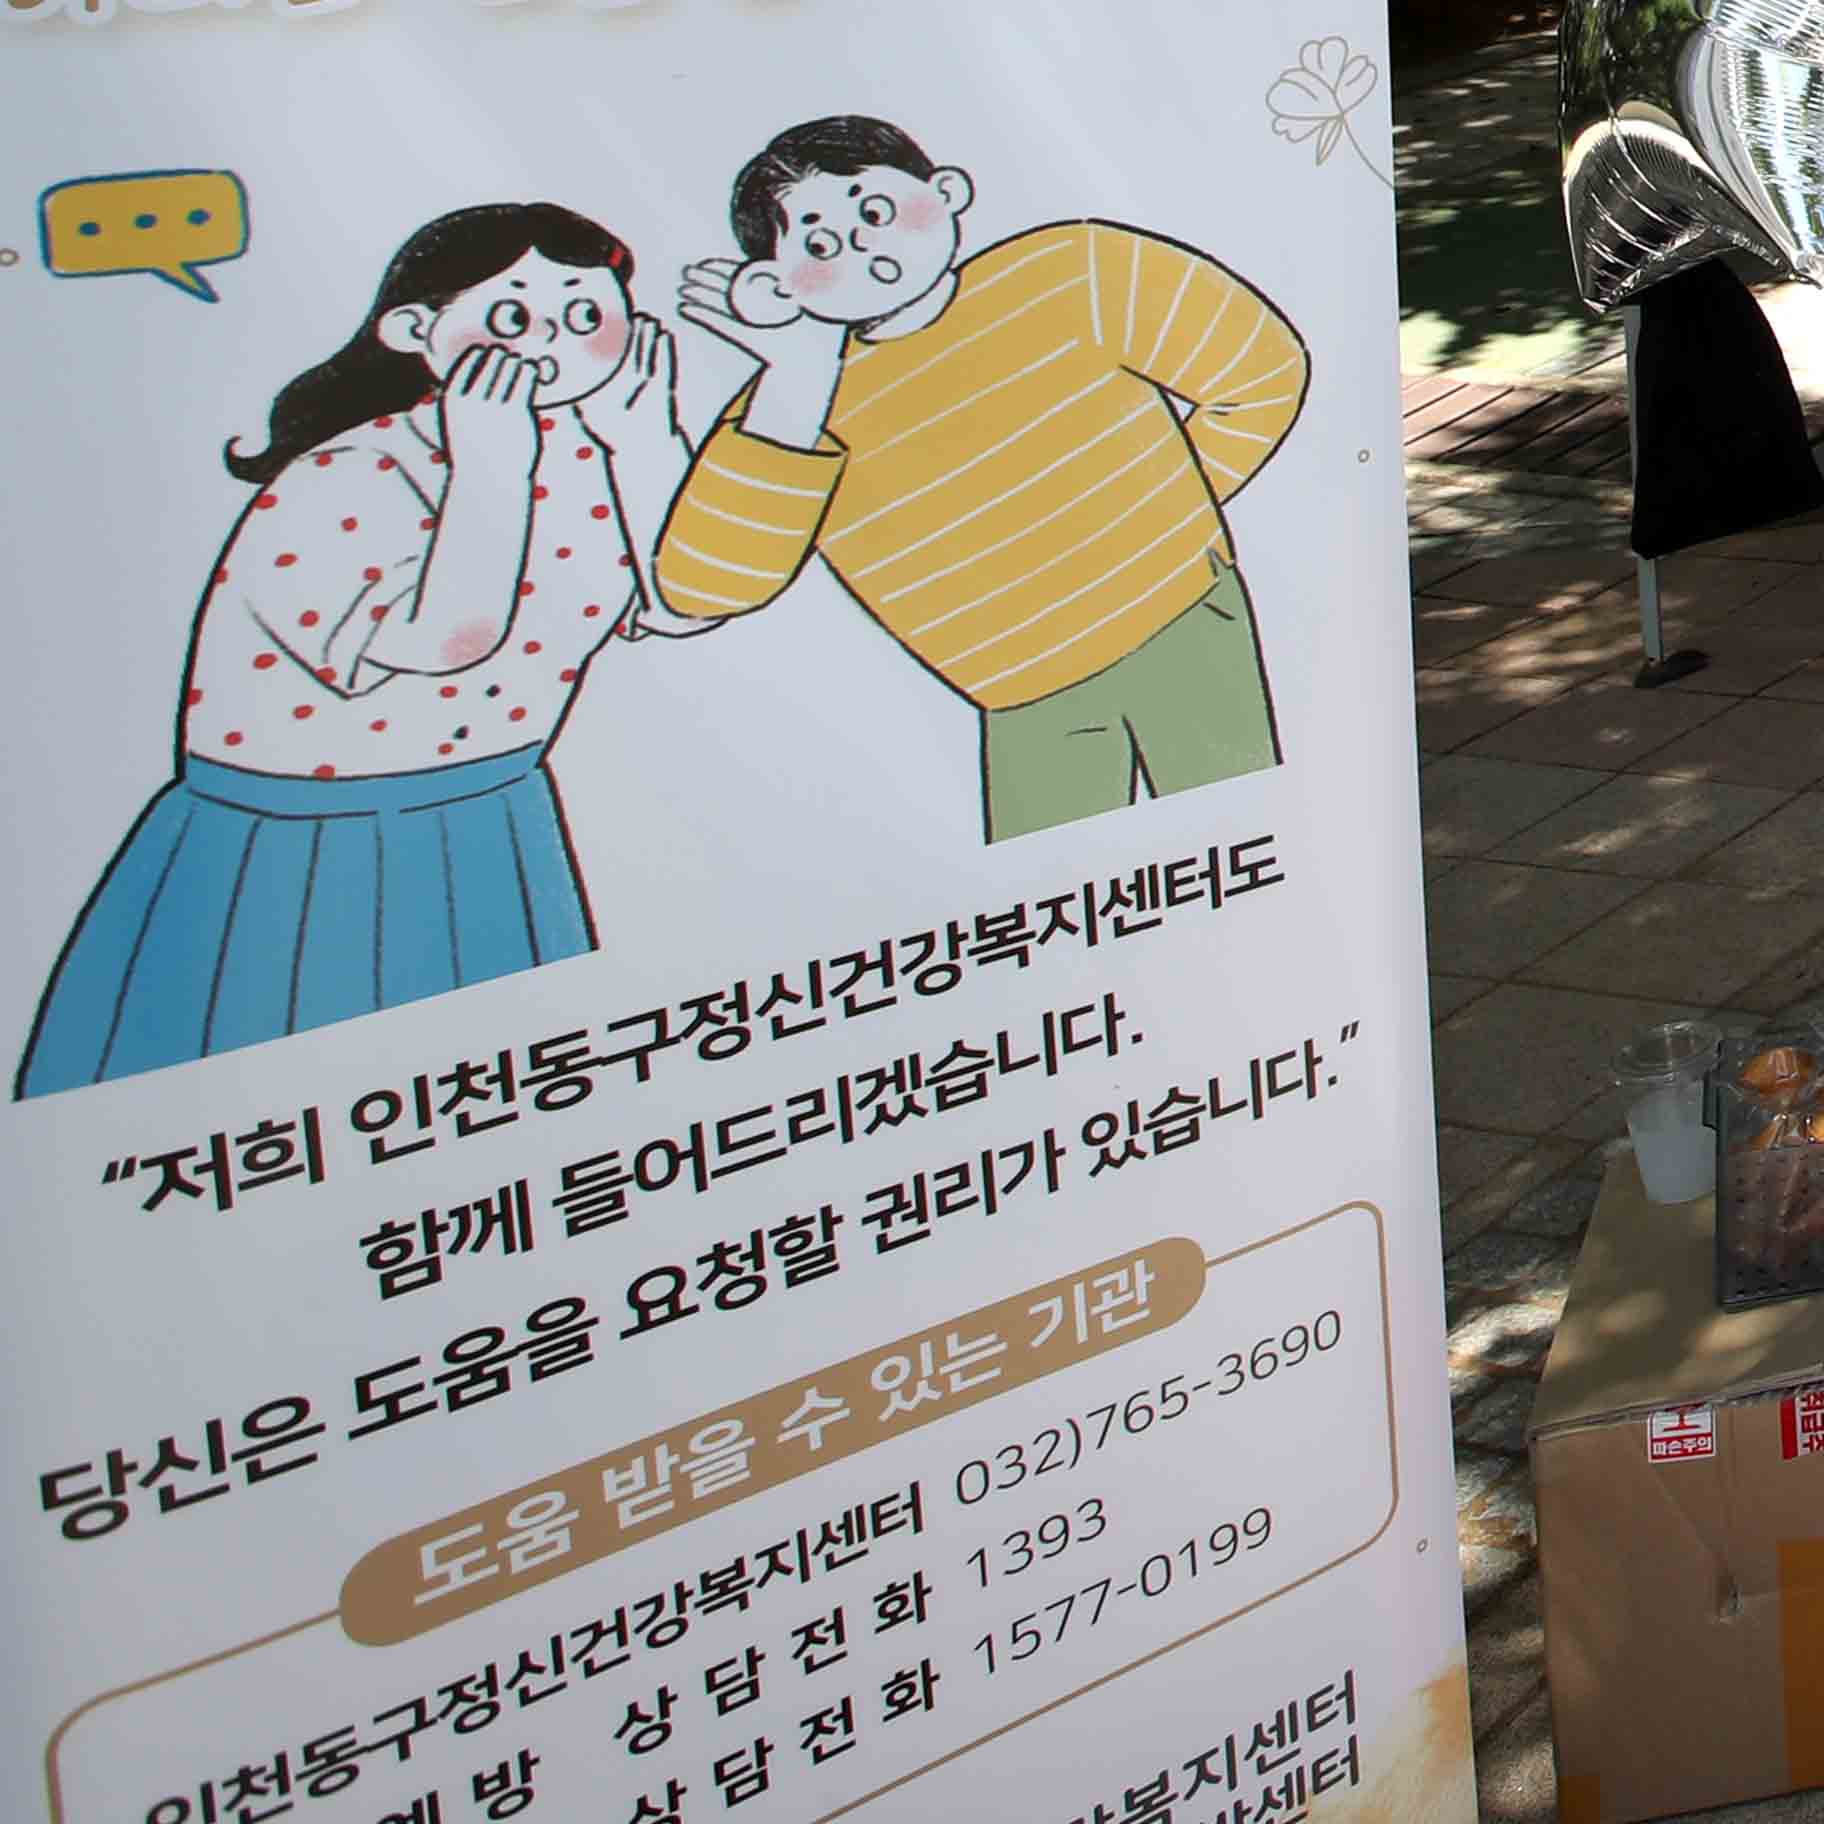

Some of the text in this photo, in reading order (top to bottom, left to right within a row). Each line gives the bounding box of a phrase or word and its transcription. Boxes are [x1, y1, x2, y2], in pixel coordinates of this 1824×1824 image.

[349, 831, 1285, 1168] 인천동구정신건강복지센터도
[358, 991, 1146, 1301] 함께 들어드리겠습니다.
[38, 1393, 323, 1543] 당신은
[348, 1295, 599, 1445] 도움을
[618, 1205, 843, 1341] 요청할
[860, 1124, 1065, 1258] 권리가
[412, 1258, 1158, 1607] 도움 받을 수 있는 기관
[954, 1306, 1346, 1508] 032)765-3690
[1652, 1435, 1712, 1457] 파손주의
[965, 1496, 1109, 1590] 1393
[974, 1505, 1275, 1676] 1577-0199
